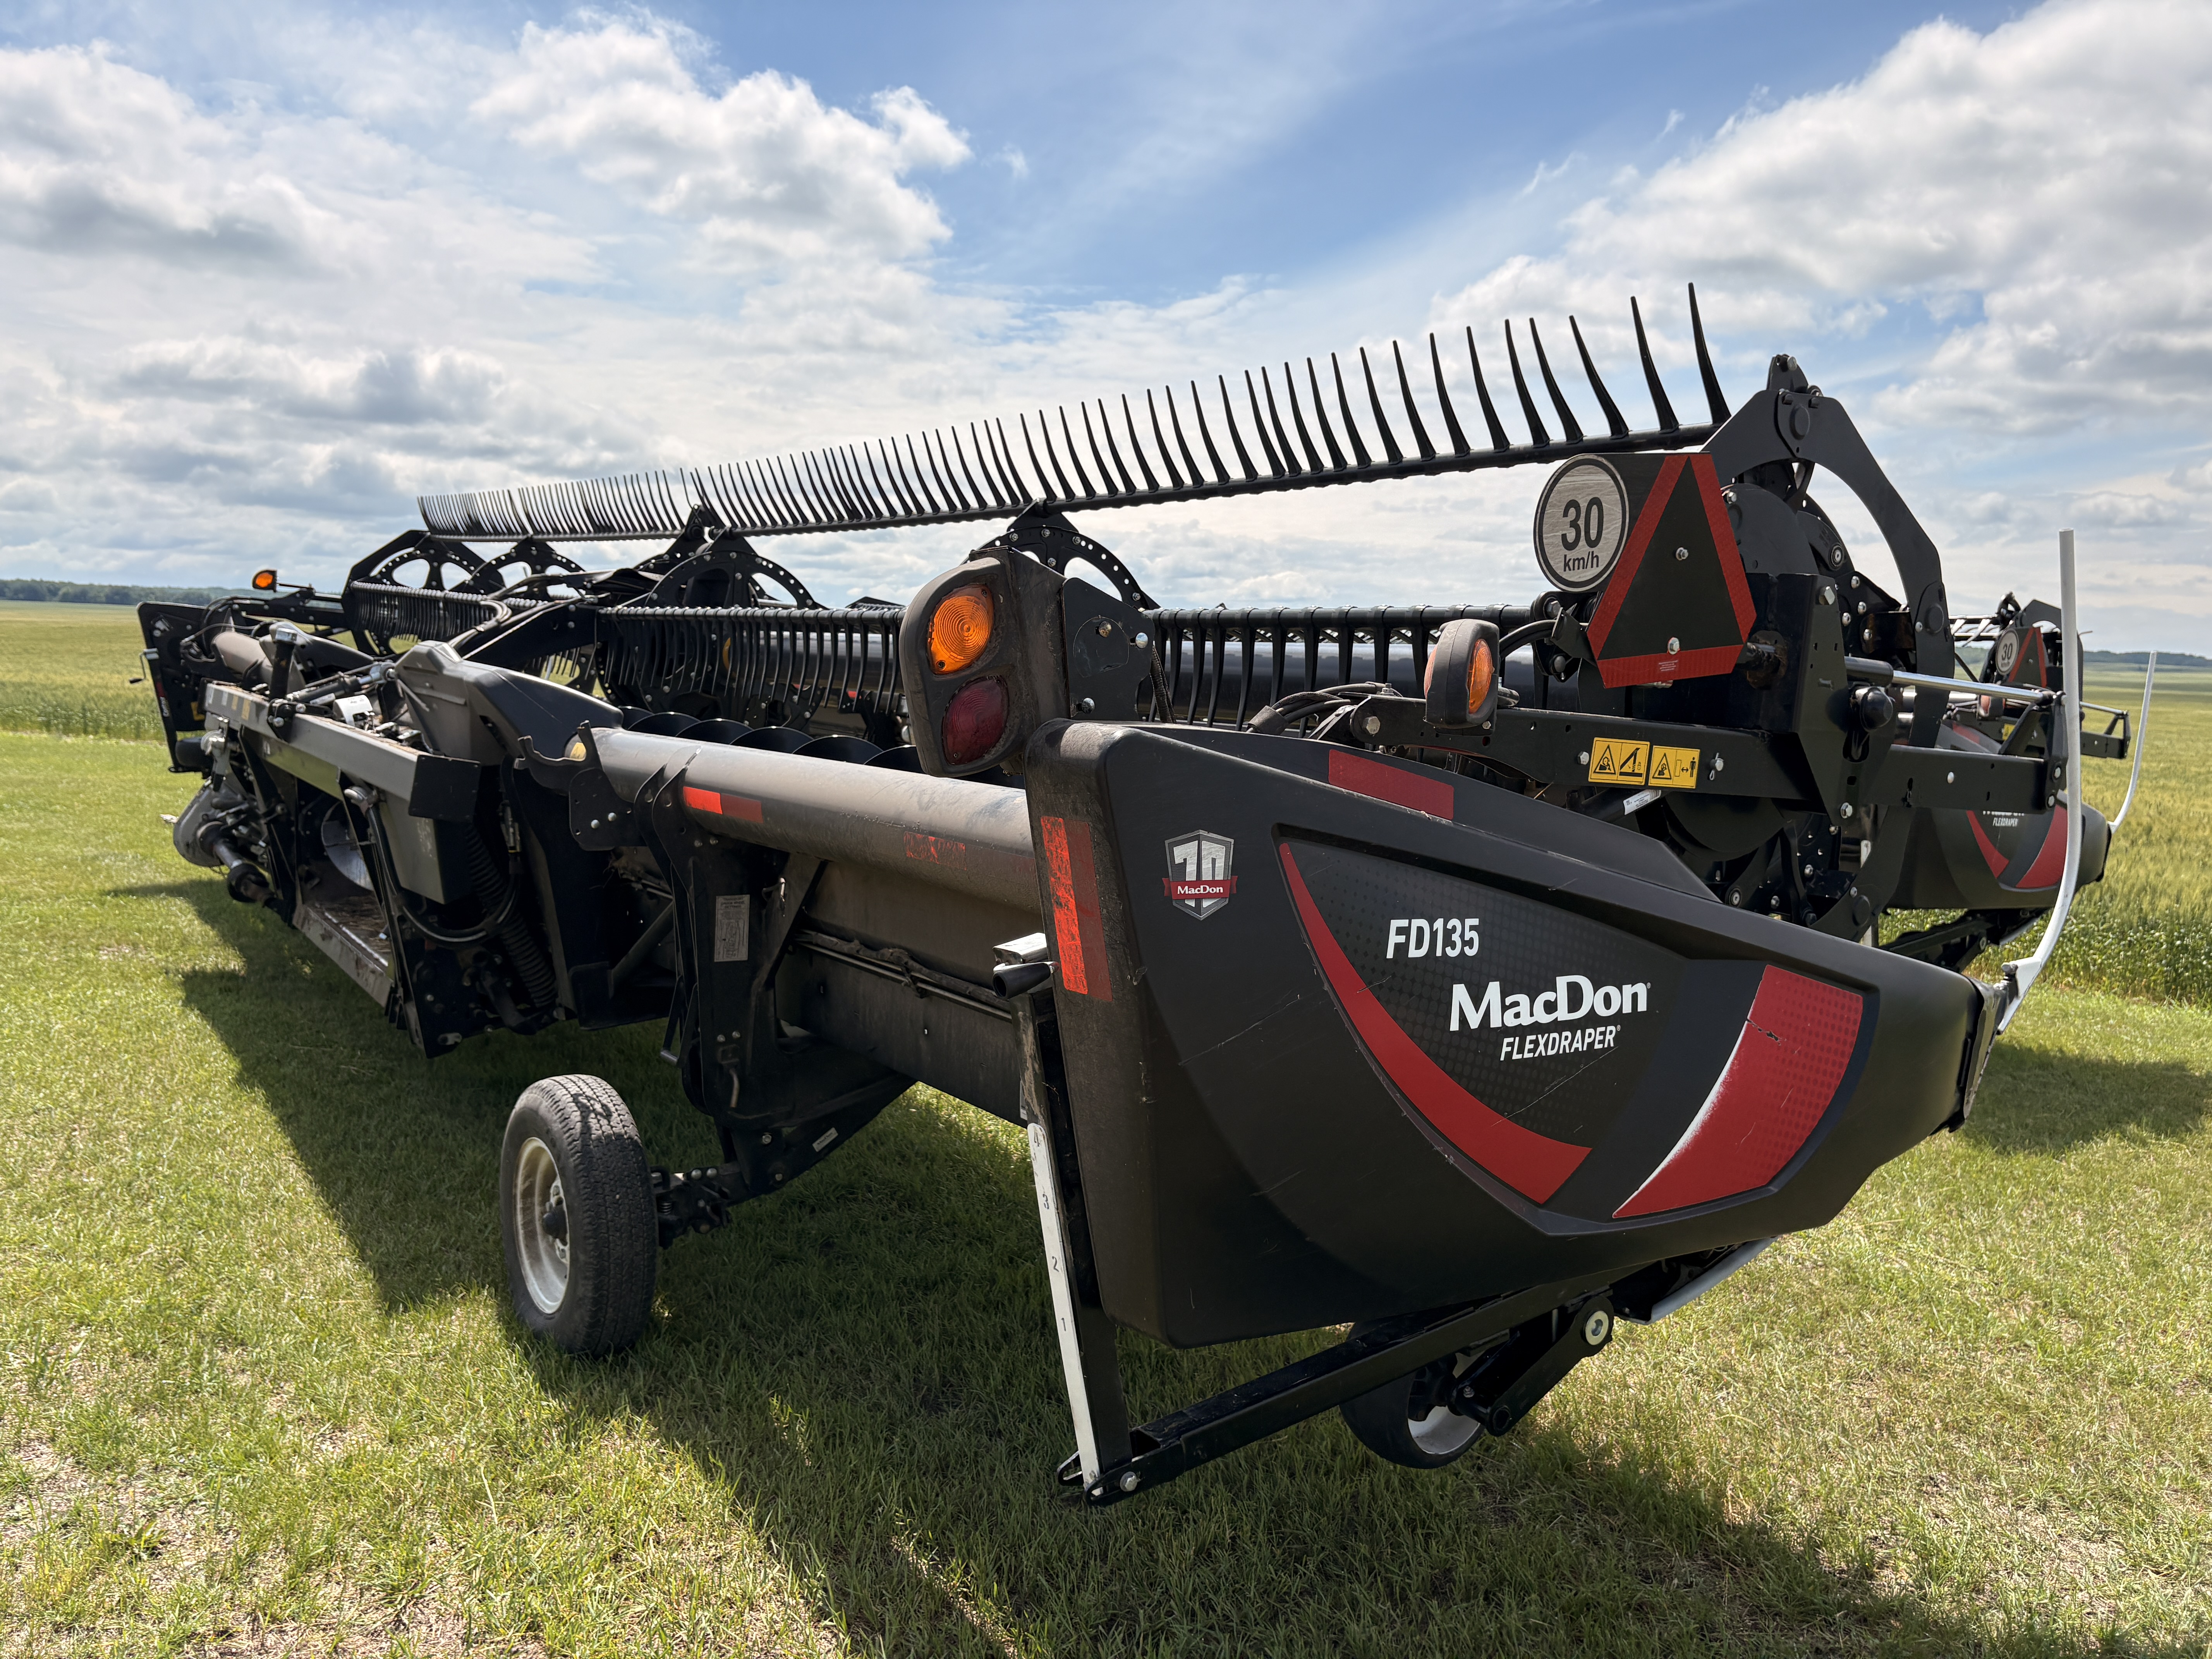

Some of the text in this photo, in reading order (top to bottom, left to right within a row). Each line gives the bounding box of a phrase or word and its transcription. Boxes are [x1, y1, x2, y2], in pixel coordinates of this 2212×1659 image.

[1561, 496, 1604, 551] 30
[1563, 551, 1599, 572] km/h
[2001, 643, 2013, 661] 30
[1177, 885, 1224, 895] MacDon
[1386, 918, 1479, 959] FD135
[1449, 975, 1647, 1031] MacDon
[1500, 1025, 1616, 1061] FLEXDRAPER
[1042, 1194, 1049, 1209] 3
[1052, 1256, 1060, 1273] 2
[1061, 1317, 1066, 1331] 1
